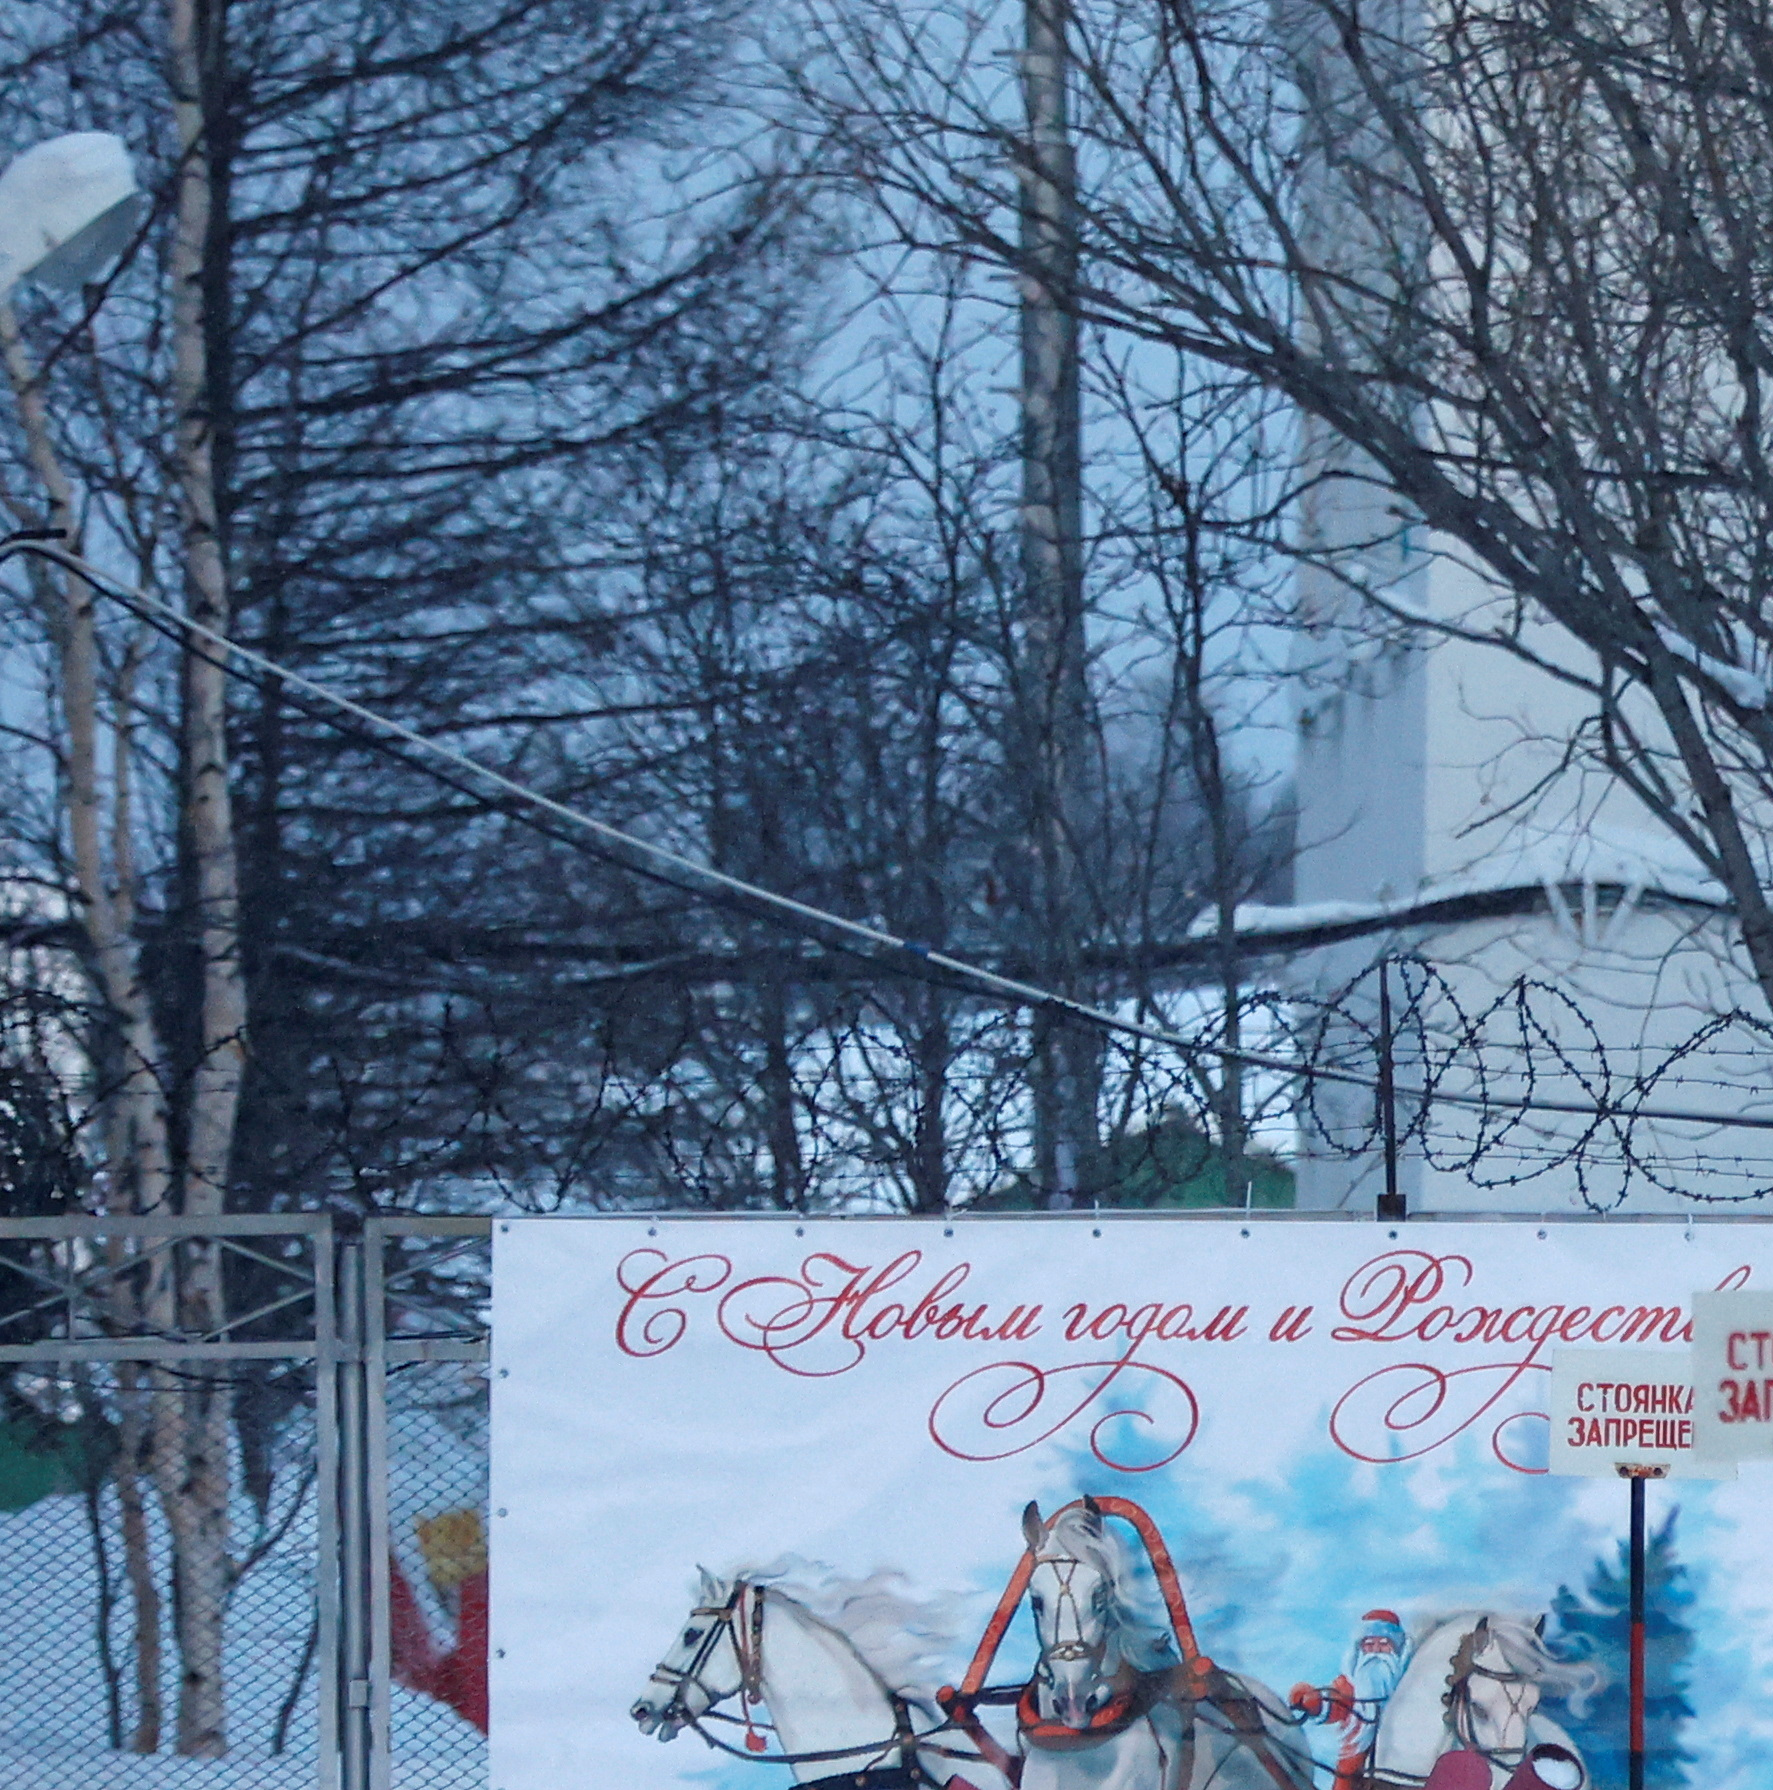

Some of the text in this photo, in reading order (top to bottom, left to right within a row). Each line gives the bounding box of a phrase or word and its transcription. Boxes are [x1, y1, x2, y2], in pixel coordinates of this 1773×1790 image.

[615, 1248, 732, 1358] С
[717, 1250, 1042, 1377] Новым
[1268, 1304, 1312, 1342] и
